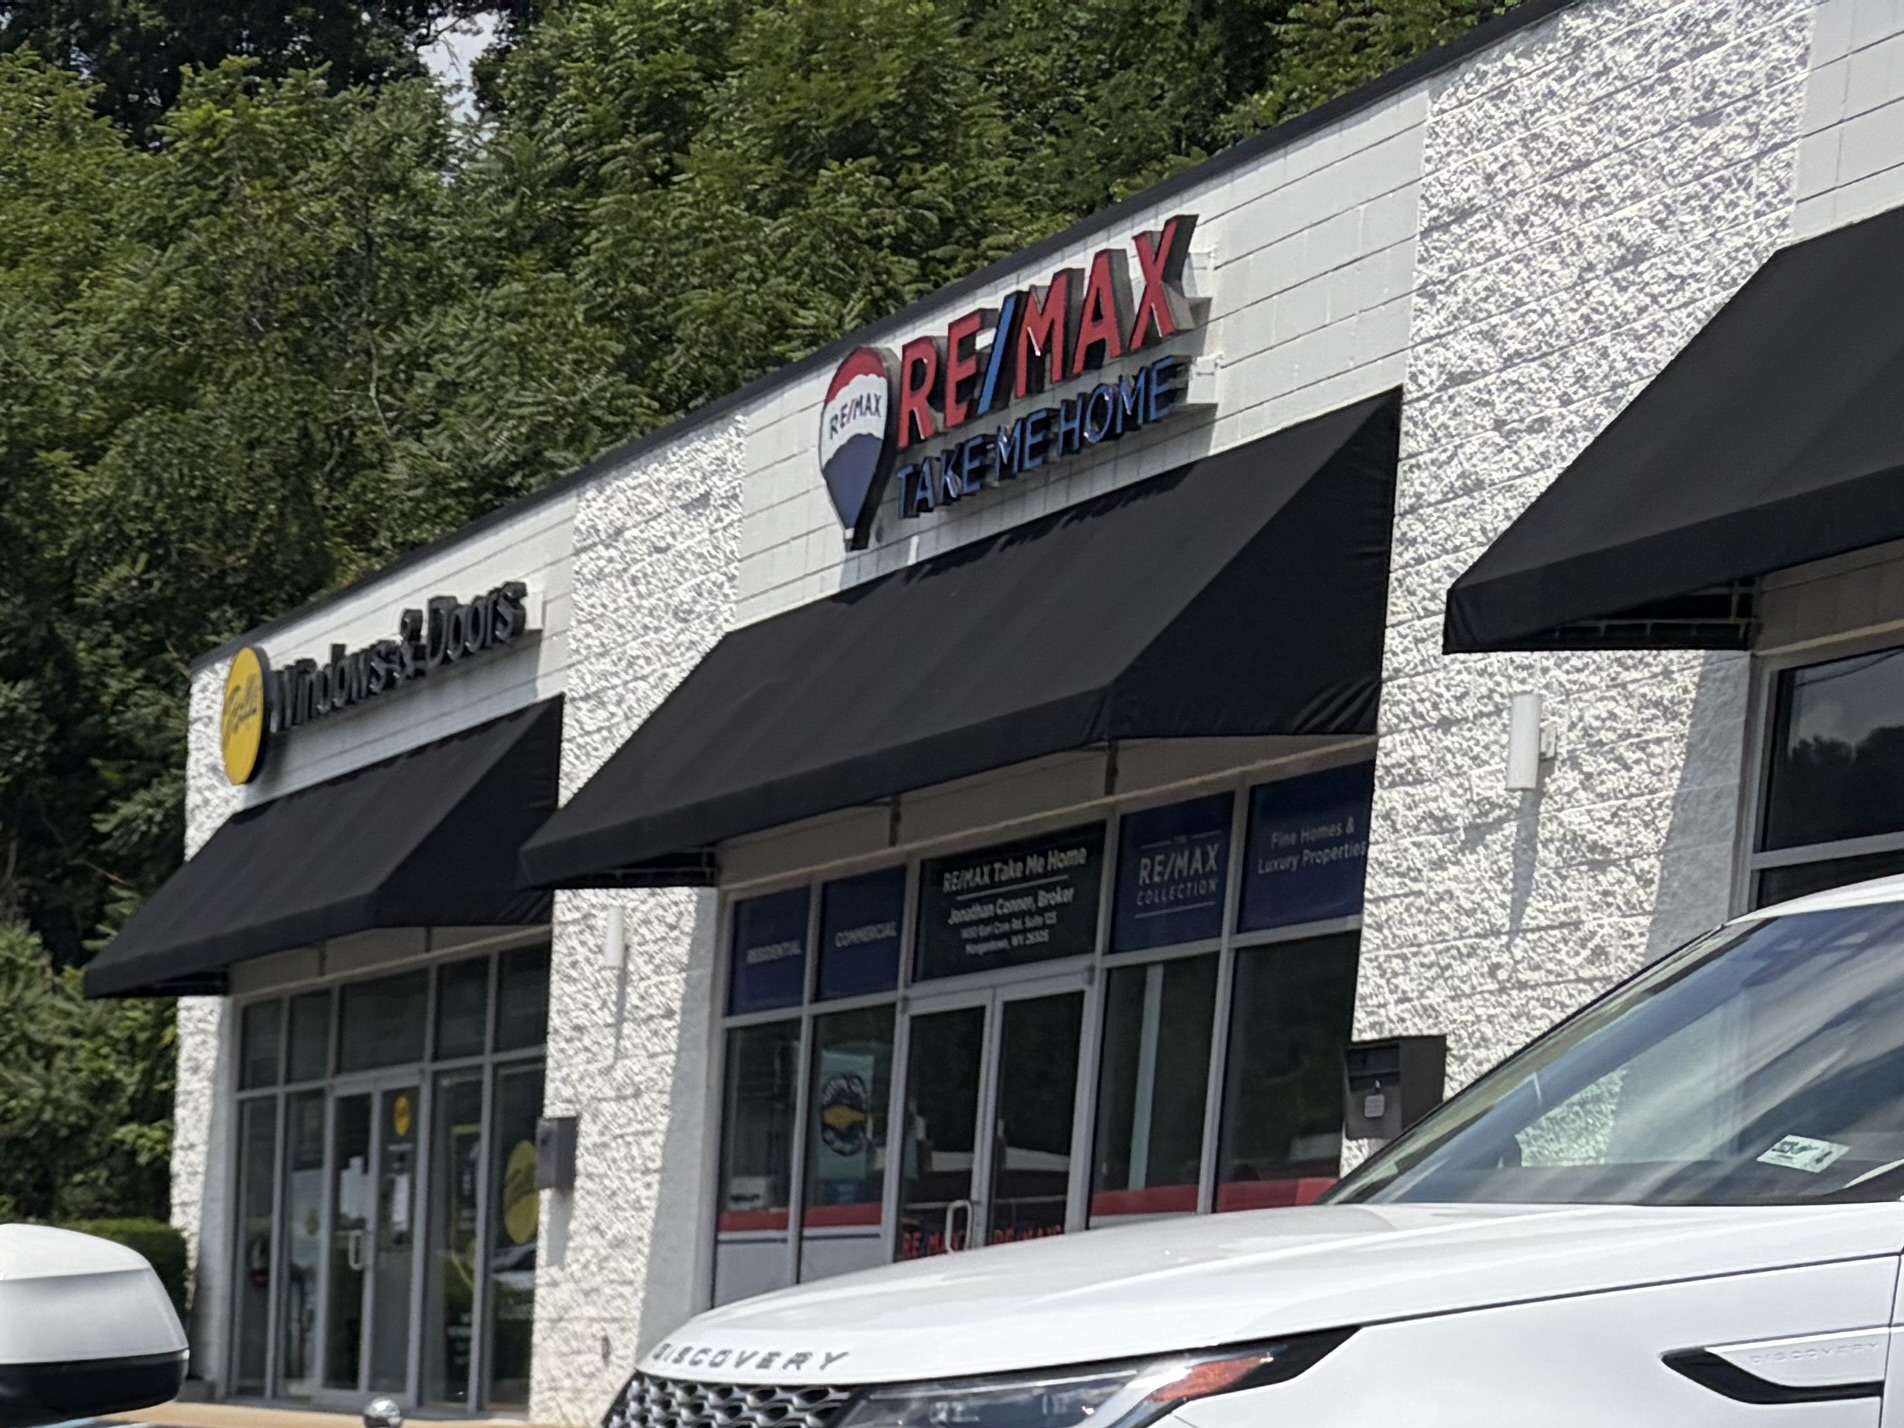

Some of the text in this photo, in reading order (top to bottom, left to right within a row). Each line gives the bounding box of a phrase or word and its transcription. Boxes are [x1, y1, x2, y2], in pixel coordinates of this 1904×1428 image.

[898, 215, 1192, 449] RE/MAX
[829, 392, 882, 440] RE/MAX
[897, 356, 1183, 519] TAKE ME HOME
[427, 580, 527, 669] Doors
[1270, 816, 1355, 849] Fine Homes &
[943, 847, 1088, 893] RE/MAX Take Me Home
[1139, 843, 1219, 886] RE/MAX
[1258, 839, 1368, 875] Luxury Properties
[1136, 878, 1218, 906] COLLECTION
[652, 1343, 850, 1371] DISCOVERY
